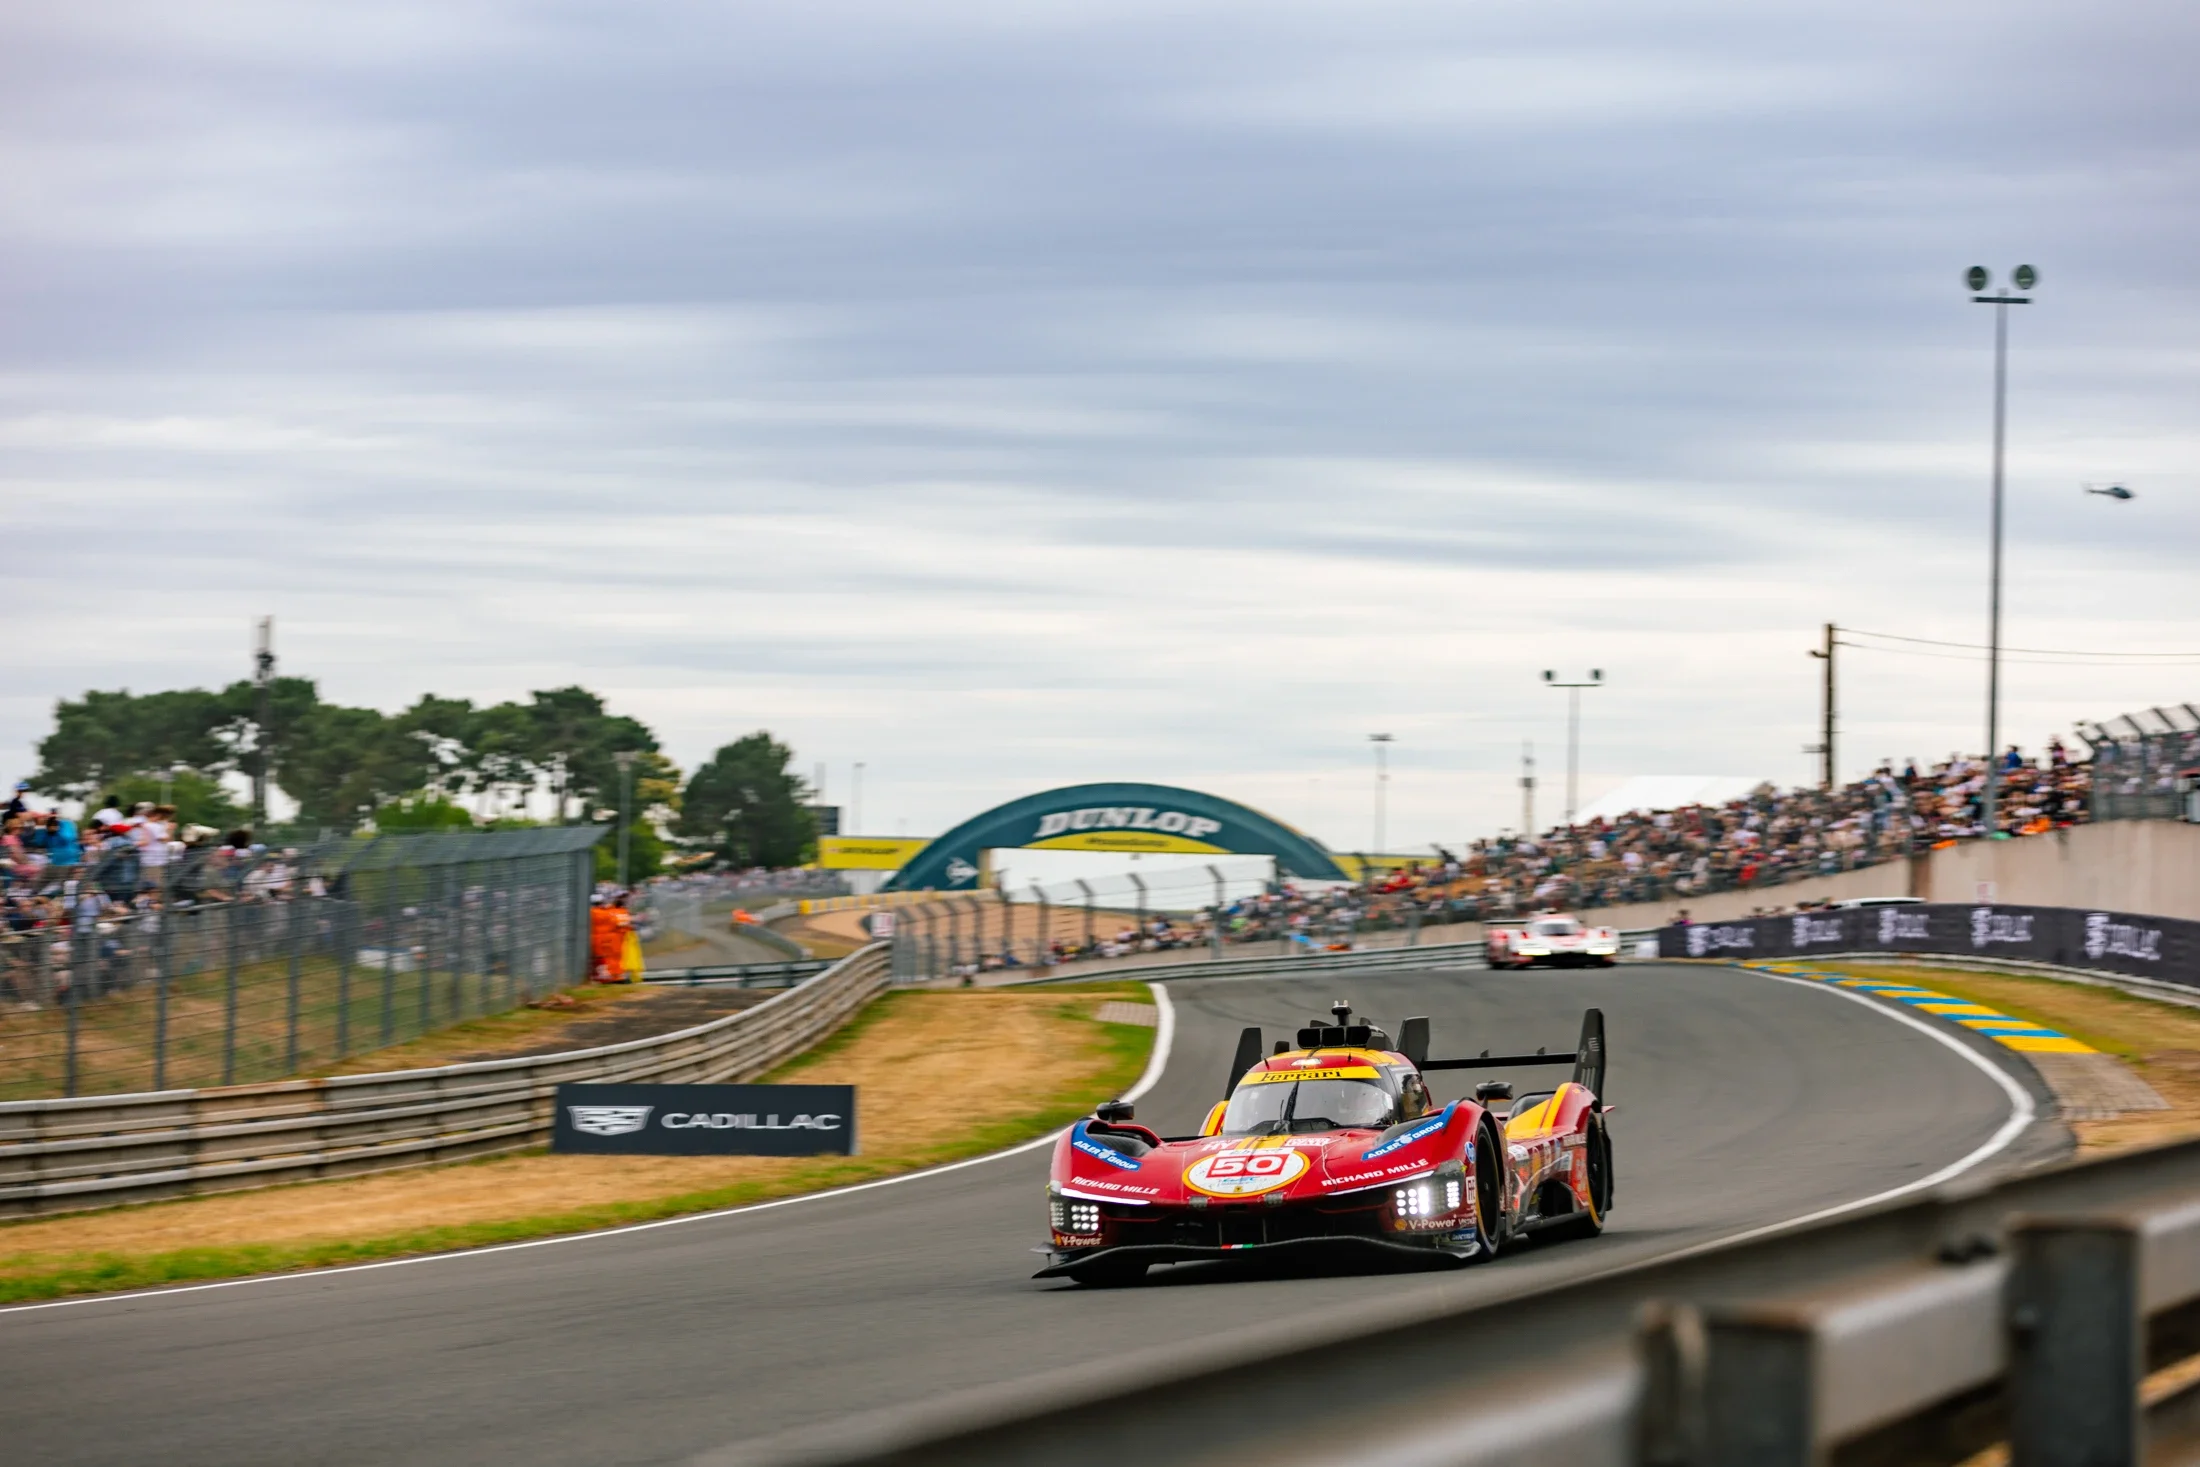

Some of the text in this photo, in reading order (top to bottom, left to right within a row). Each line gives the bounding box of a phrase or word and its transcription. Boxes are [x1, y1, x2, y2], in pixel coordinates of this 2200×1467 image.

[1033, 807, 1222, 838] DUNLOP
[1260, 1069, 1344, 1082] Ferrari
[661, 1112, 842, 1131] CADILLAC
[1367, 1121, 1444, 1159] ADLER GROUP
[1073, 1140, 1138, 1170] ADLER GROUP
[1211, 1156, 1283, 1175] 50
[1321, 1158, 1429, 1187] RICHARD MILLE
[1071, 1176, 1160, 1195] RICHARD MILLE
[1409, 1219, 1456, 1230] V-Power
[1061, 1235, 1102, 1246] V-Power
